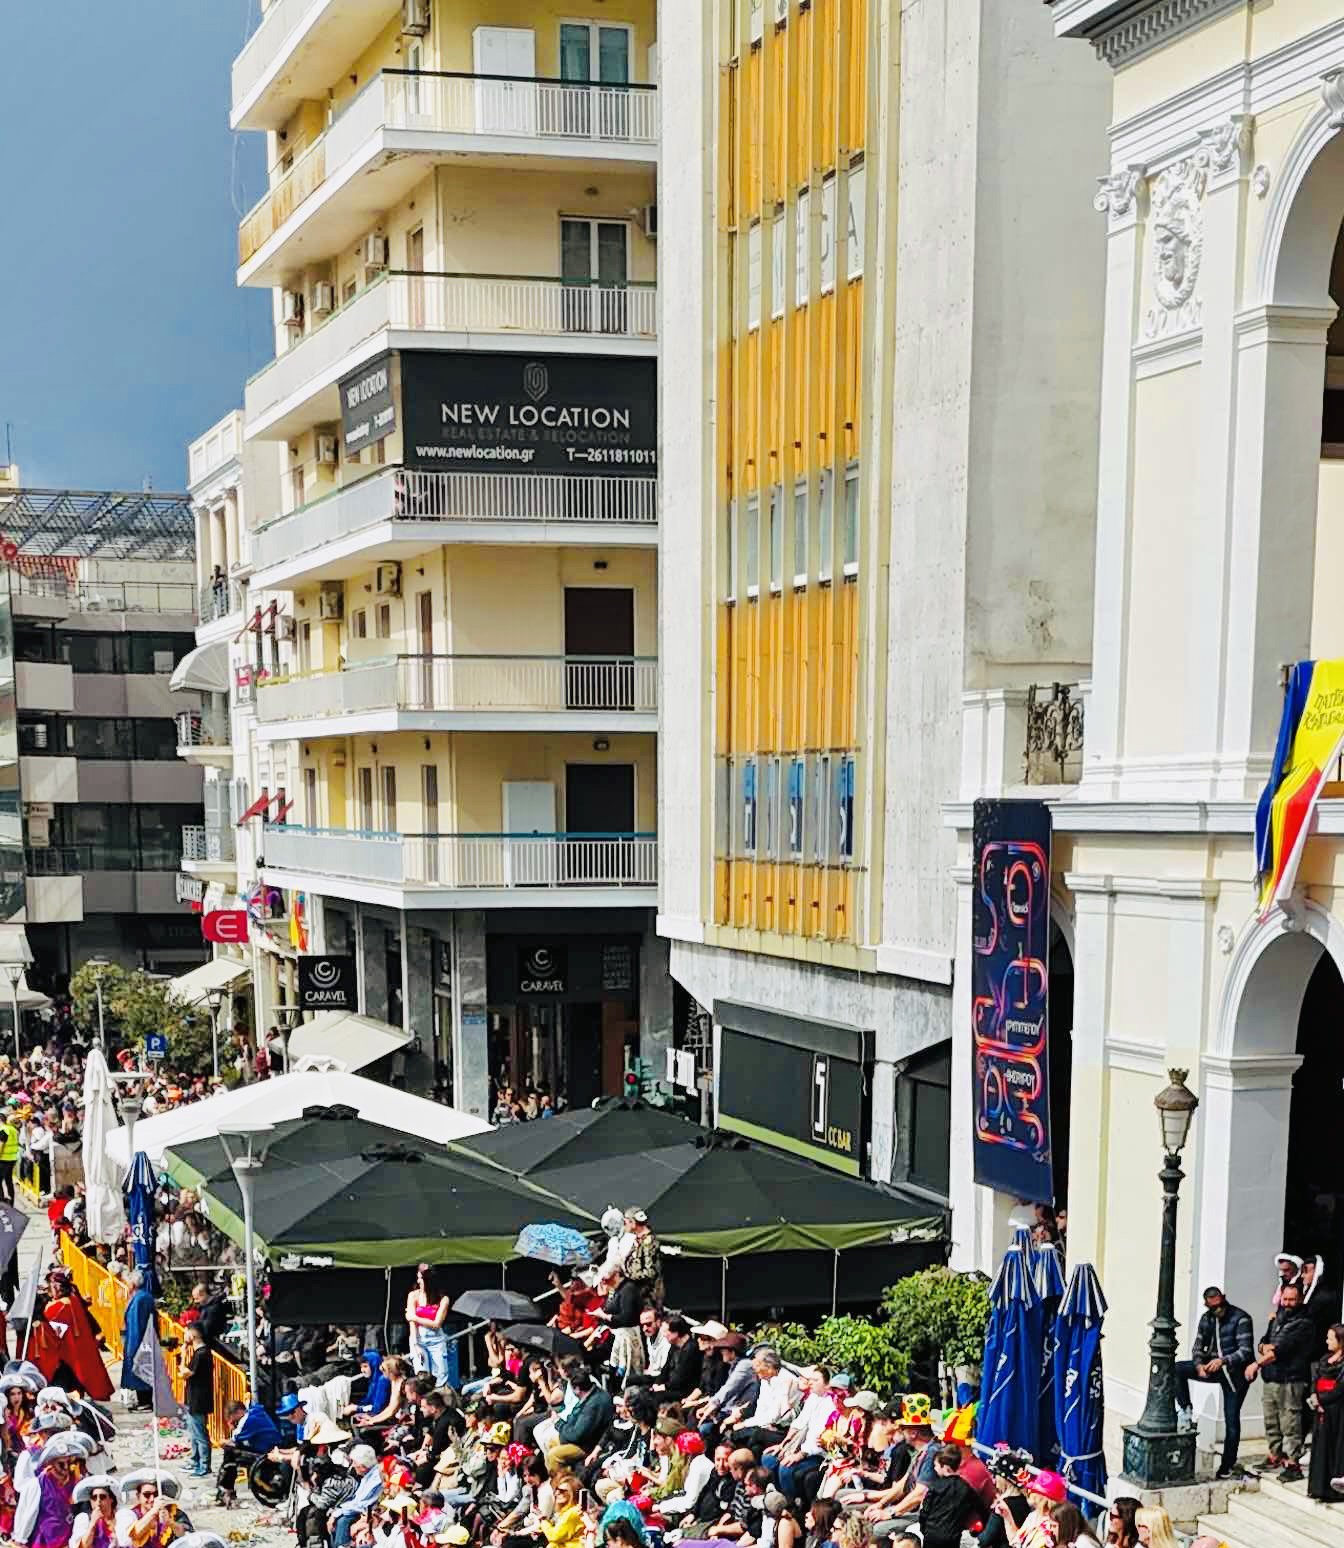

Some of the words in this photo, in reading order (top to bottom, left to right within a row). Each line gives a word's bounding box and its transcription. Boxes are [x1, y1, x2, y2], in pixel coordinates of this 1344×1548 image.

[441, 403, 500, 425] NEW
[509, 405, 631, 429] LOCATION
[416, 445, 535, 463] www.newlocation.gr
[520, 980, 564, 993] CARAVEL
[305, 990, 348, 1001] CARAVEL
[151, 1037, 162, 1051] P
